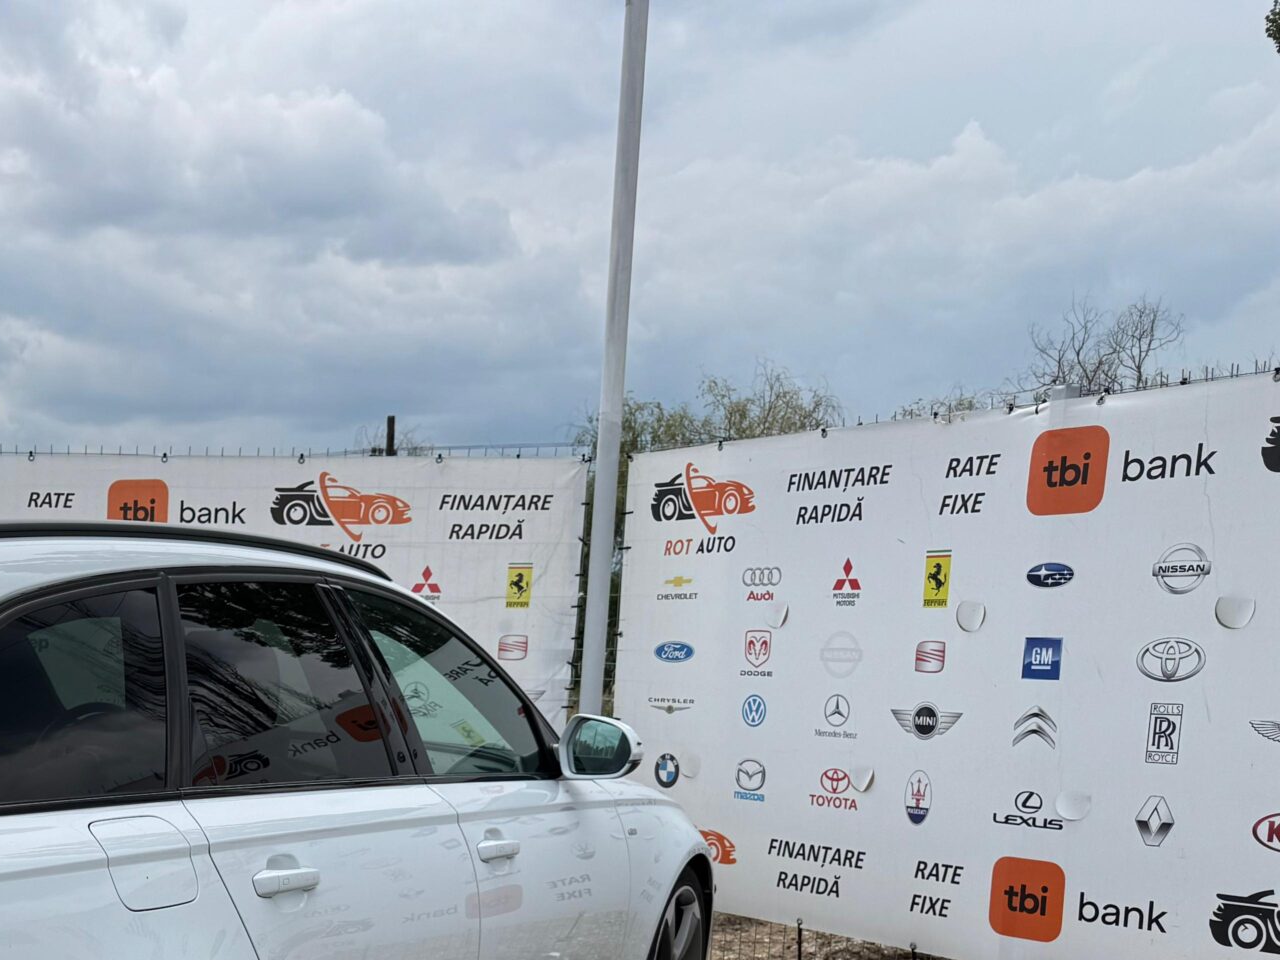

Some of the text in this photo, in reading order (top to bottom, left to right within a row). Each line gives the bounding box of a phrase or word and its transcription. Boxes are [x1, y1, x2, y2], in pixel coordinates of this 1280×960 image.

[945, 454, 1001, 478] RATE
[1043, 443, 1218, 488] tbi bank
[787, 464, 893, 495] FINANȚARE
[27, 492, 75, 508] RATE
[439, 494, 554, 516] FINANȚARE
[938, 493, 986, 516] FIXE
[120, 499, 246, 525] tbi bank
[796, 497, 863, 525] RAPIDĂ
[449, 519, 524, 540] RAPIDĂ
[664, 536, 736, 556] ROT AUTO
[1158, 564, 1205, 574] NISSAN
[661, 644, 686, 660] Ford
[1031, 647, 1053, 665] GM
[1153, 704, 1182, 714] ROLLS
[914, 716, 937, 726] MINI
[814, 729, 858, 739] Mercedes-Benz
[1147, 752, 1177, 763] ROYCE
[734, 791, 765, 802] mazda
[809, 794, 858, 811] TOYOTA
[993, 813, 1064, 831] LEXUS
[768, 839, 866, 869] FINANȚARE
[914, 860, 964, 885] RATE
[776, 871, 841, 898] RAPIDĂ
[909, 894, 951, 918] FIXE
[1004, 884, 1167, 933] tbi bank
